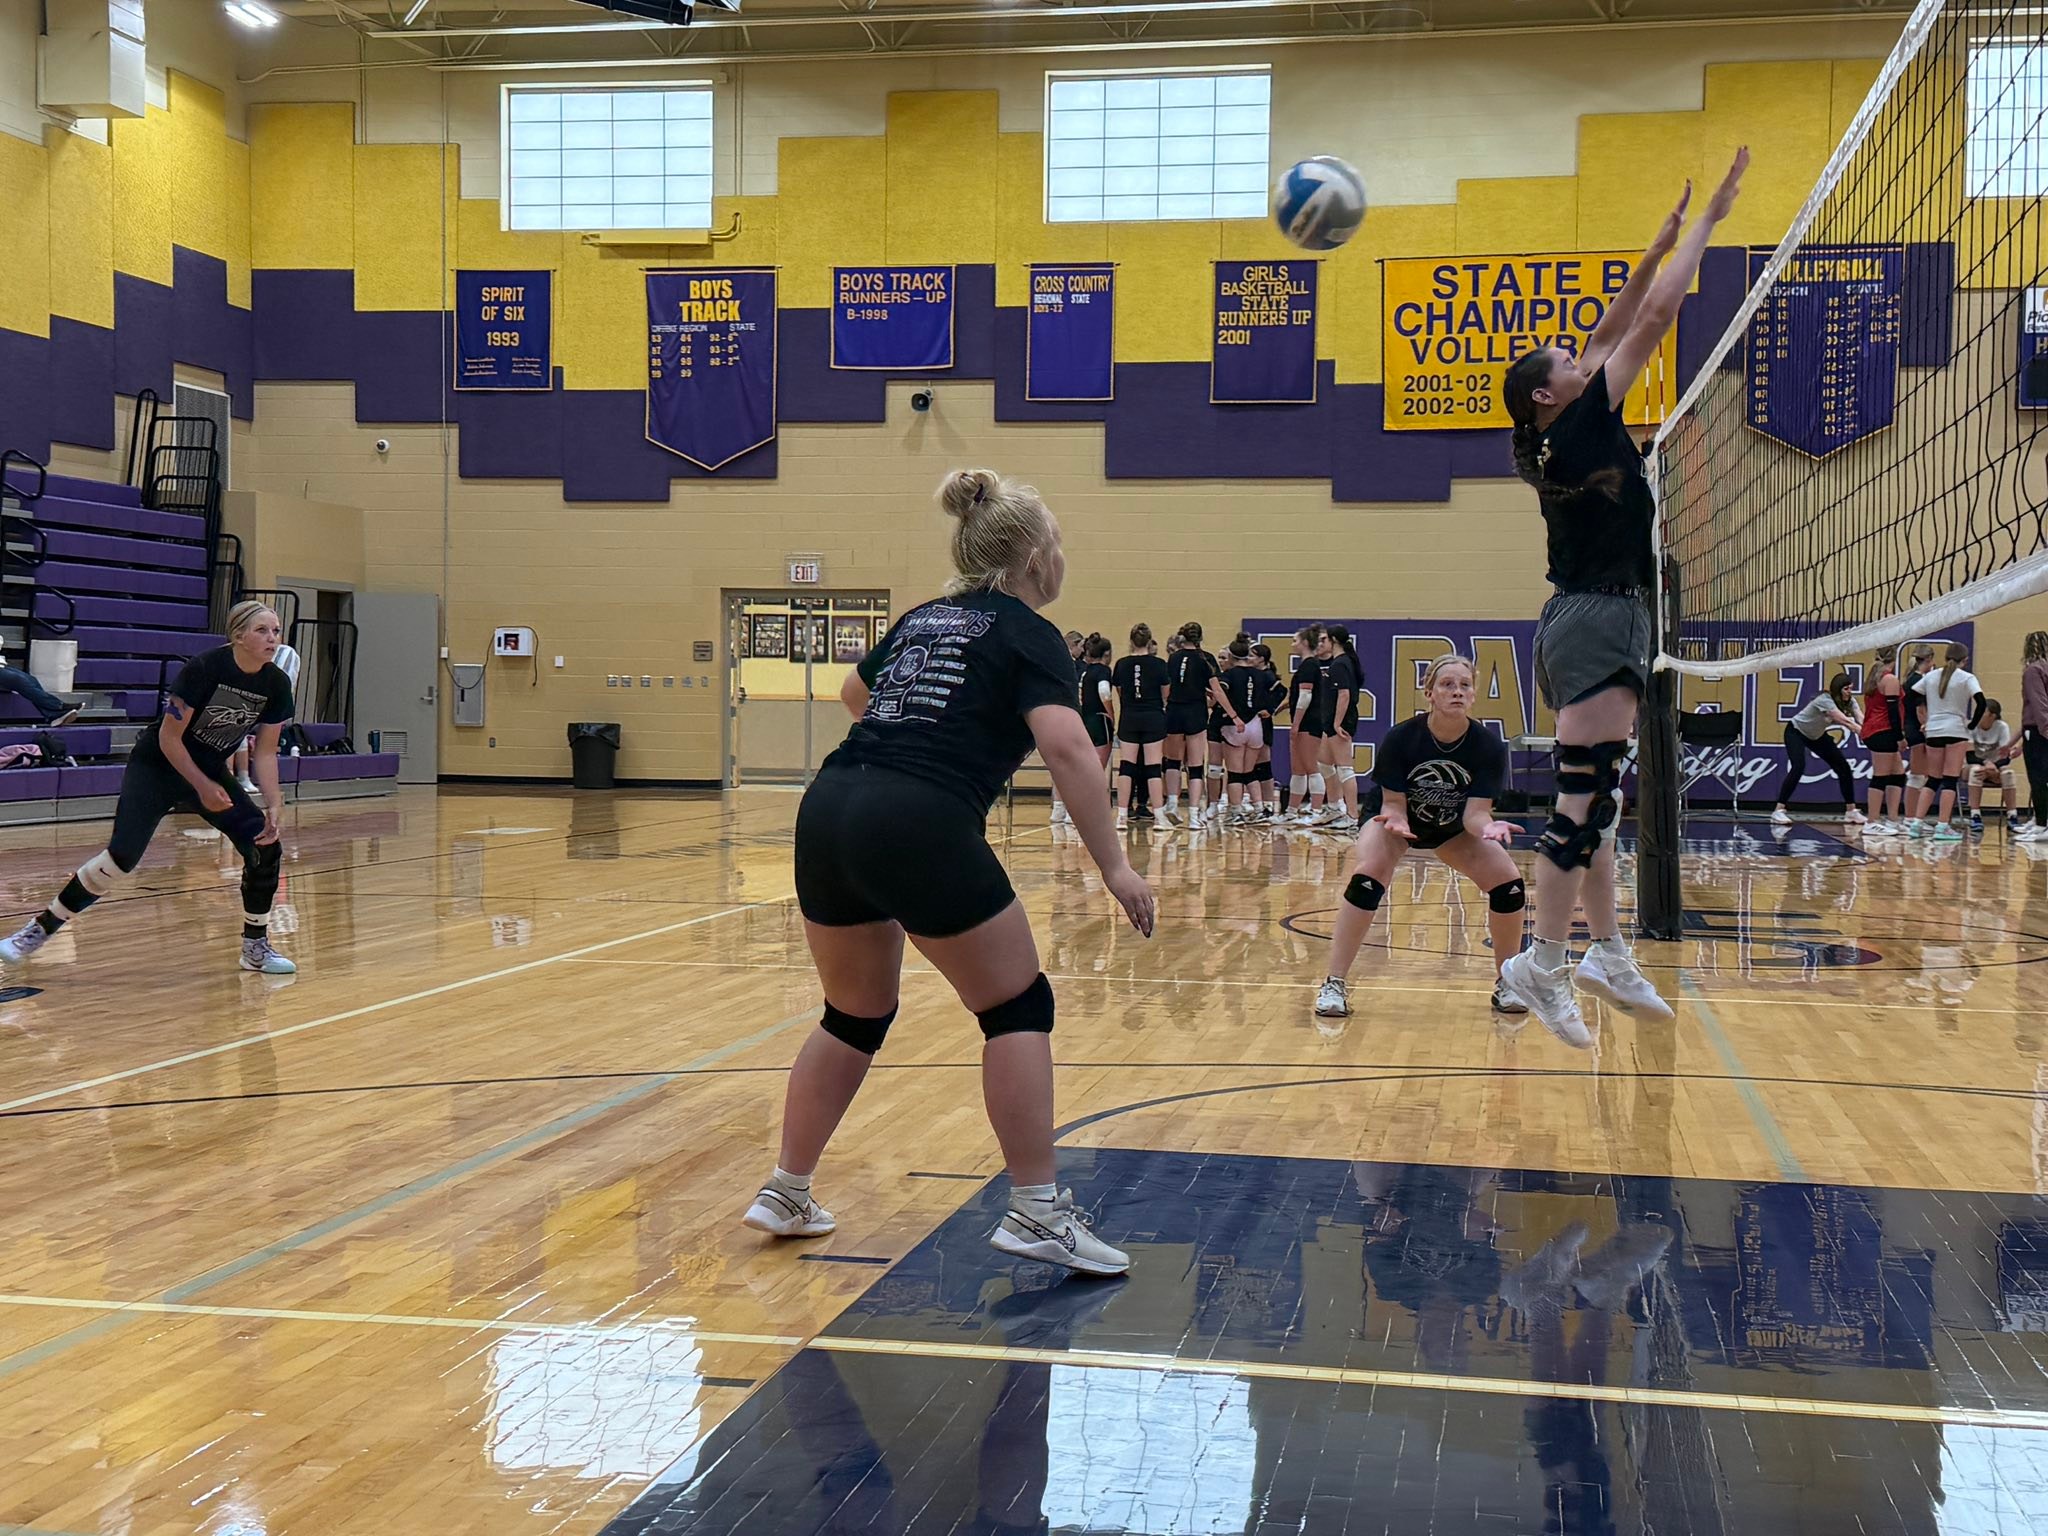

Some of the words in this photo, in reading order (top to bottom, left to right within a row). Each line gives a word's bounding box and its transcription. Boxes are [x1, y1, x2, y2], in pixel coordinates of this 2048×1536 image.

[840, 273, 884, 291] BOYS
[890, 272, 945, 291] TRACK
[1243, 265, 1289, 282] GIRLS
[1432, 261, 1581, 299] STATE
[1602, 260, 1630, 294] B
[689, 279, 733, 299] BOYS
[1034, 275, 1065, 293] CROSS
[1068, 274, 1111, 293] COUNTRY
[1221, 280, 1310, 296] BASKETBALL
[481, 287, 525, 302] SPIRIT
[1071, 293, 1090, 304] STATE
[679, 300, 741, 322] TRACK
[1241, 295, 1289, 311] STATE
[481, 306, 499, 321] OF
[503, 306, 525, 321] SIX
[847, 308, 888, 320] B-1998
[1218, 310, 1288, 327] RUNNERS
[1292, 309, 1312, 325] UP
[1394, 296, 1615, 337] CHAMPIO
[729, 323, 756, 332] STATE
[486, 331, 520, 347] 1993
[1217, 330, 1250, 345] 2001
[1403, 374, 1492, 393] 2001-02
[1403, 396, 1492, 416] 2002-03
[795, 565, 813, 581] EXIT
